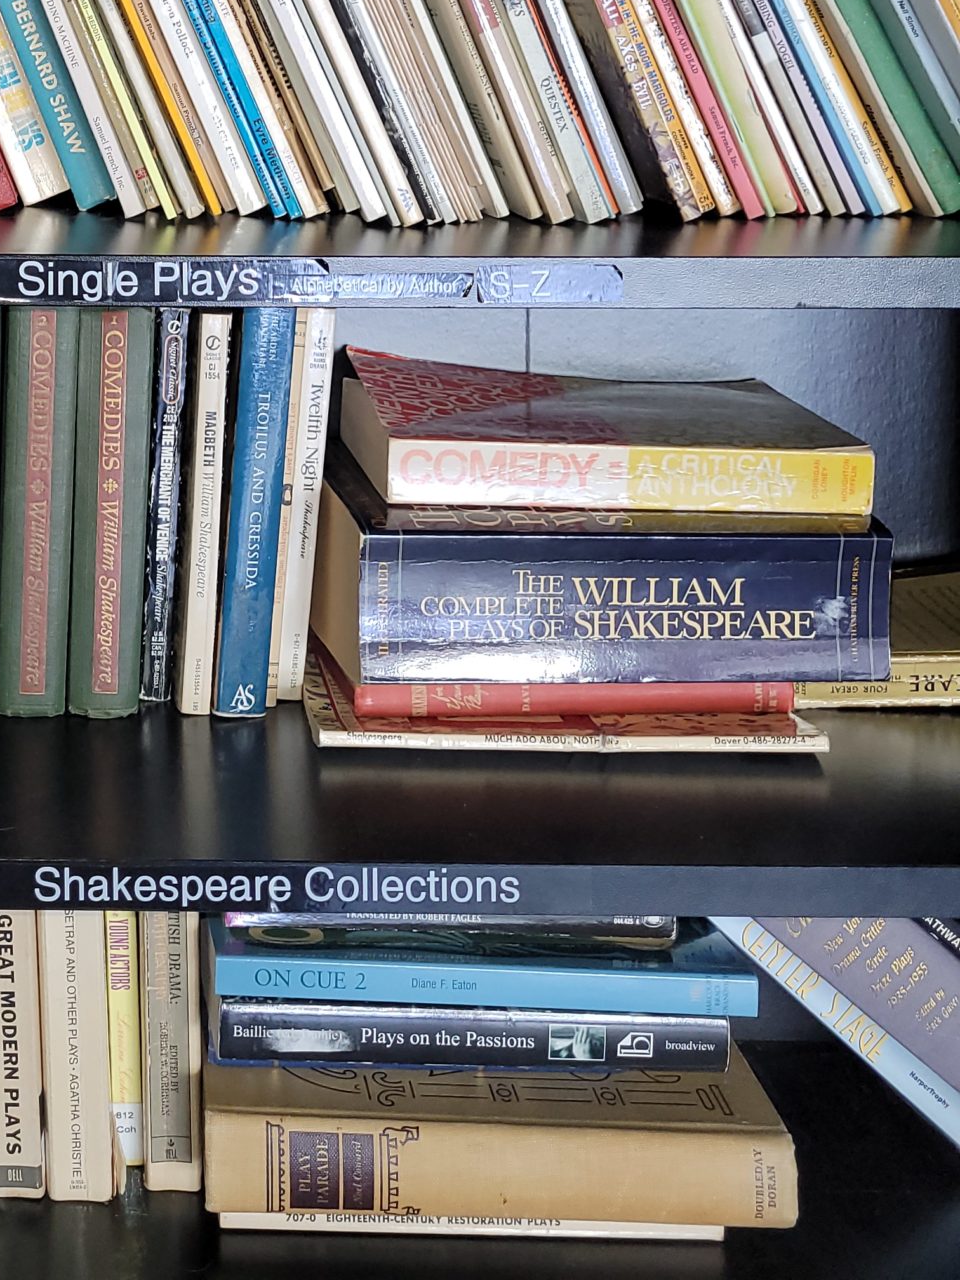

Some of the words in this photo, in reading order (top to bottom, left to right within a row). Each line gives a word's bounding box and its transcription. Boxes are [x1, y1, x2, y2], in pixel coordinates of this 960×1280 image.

[12, 0, 62, 88] BERNARD
[51, 97, 88, 153] SHAW
[19, 260, 138, 300] Single
[155, 260, 260, 299] Plays
[292, 278, 380, 293] Alphabetical
[386, 278, 404, 293] by
[409, 278, 458, 292] Author
[103, 330, 123, 470] COMEDIES
[203, 411, 218, 467] MACBETH
[254, 393, 271, 460] TROILUS
[251, 467, 266, 503] AND
[245, 513, 262, 588] CRESSIDA
[513, 570, 564, 596] THE
[573, 577, 745, 606] WILLIAM
[421, 596, 564, 617] COMPLETE
[573, 610, 816, 639] SHAKESPEARE
[449, 620, 524, 641] PLAYS
[529, 620, 564, 640] OF
[34, 866, 291, 905] Shakespeare
[305, 868, 520, 903] Collections
[254, 968, 294, 987] ON
[301, 969, 345, 989] CUE
[355, 971, 367, 990] 2
[1, 991, 18, 1080] MODERN
[361, 1028, 406, 1046] Plays
[410, 1034, 431, 1046] on
[435, 1030, 461, 1047] the
[466, 1031, 535, 1049] Passions
[665, 1040, 715, 1052] broadview
[70, 1074, 80, 1120] AGATHA
[5, 1088, 21, 1154] PLAYS
[71, 1124, 82, 1177] CHRISTIE
[754, 1149, 763, 1218] DOUBLEDAY
[767, 1166, 777, 1208] DORAN
